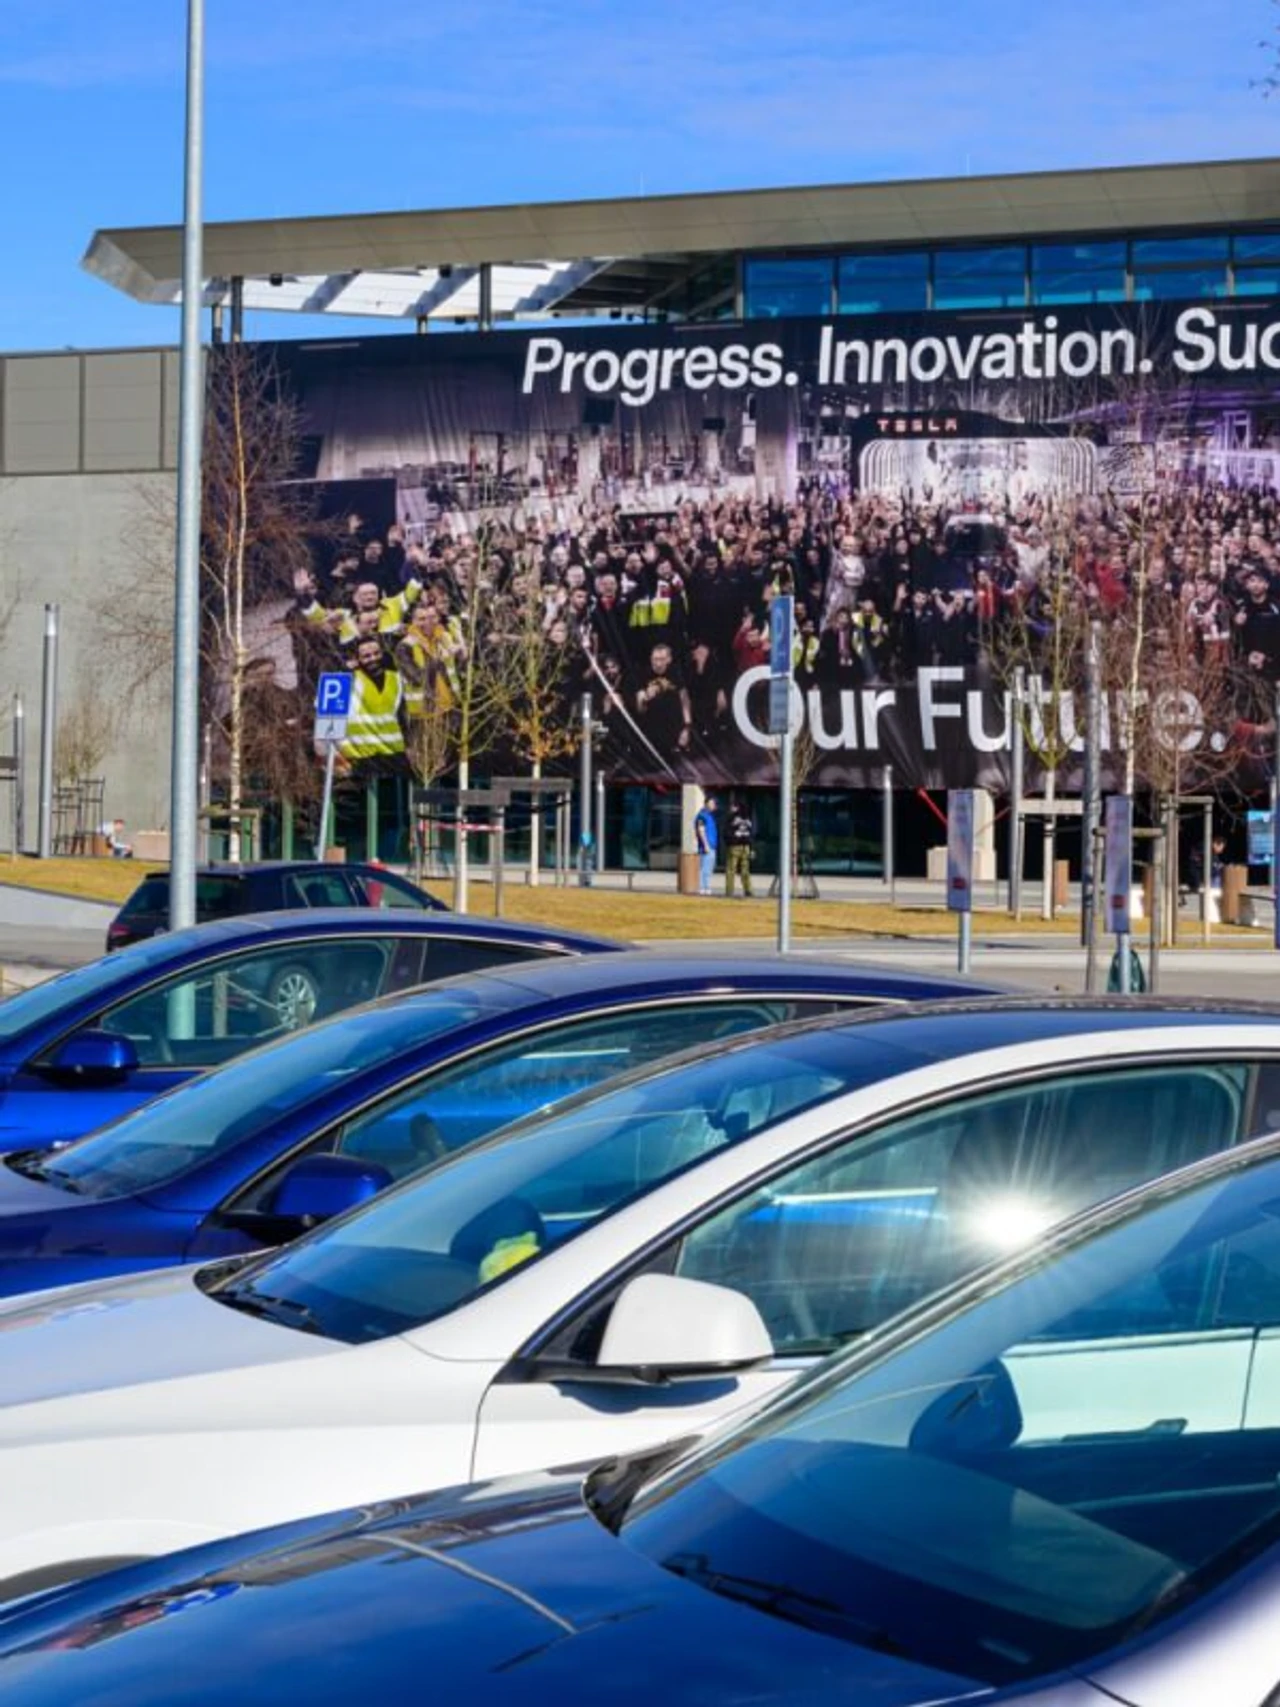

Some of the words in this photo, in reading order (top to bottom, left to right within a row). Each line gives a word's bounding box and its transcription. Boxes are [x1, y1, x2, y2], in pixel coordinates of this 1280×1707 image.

[522, 337, 798, 406] Progress.
[818, 316, 1152, 386] Innovation.
[877, 418, 957, 433] TESLA
[322, 679, 342, 711] P
[732, 663, 897, 751] Our
[917, 665, 1227, 752] Future.
